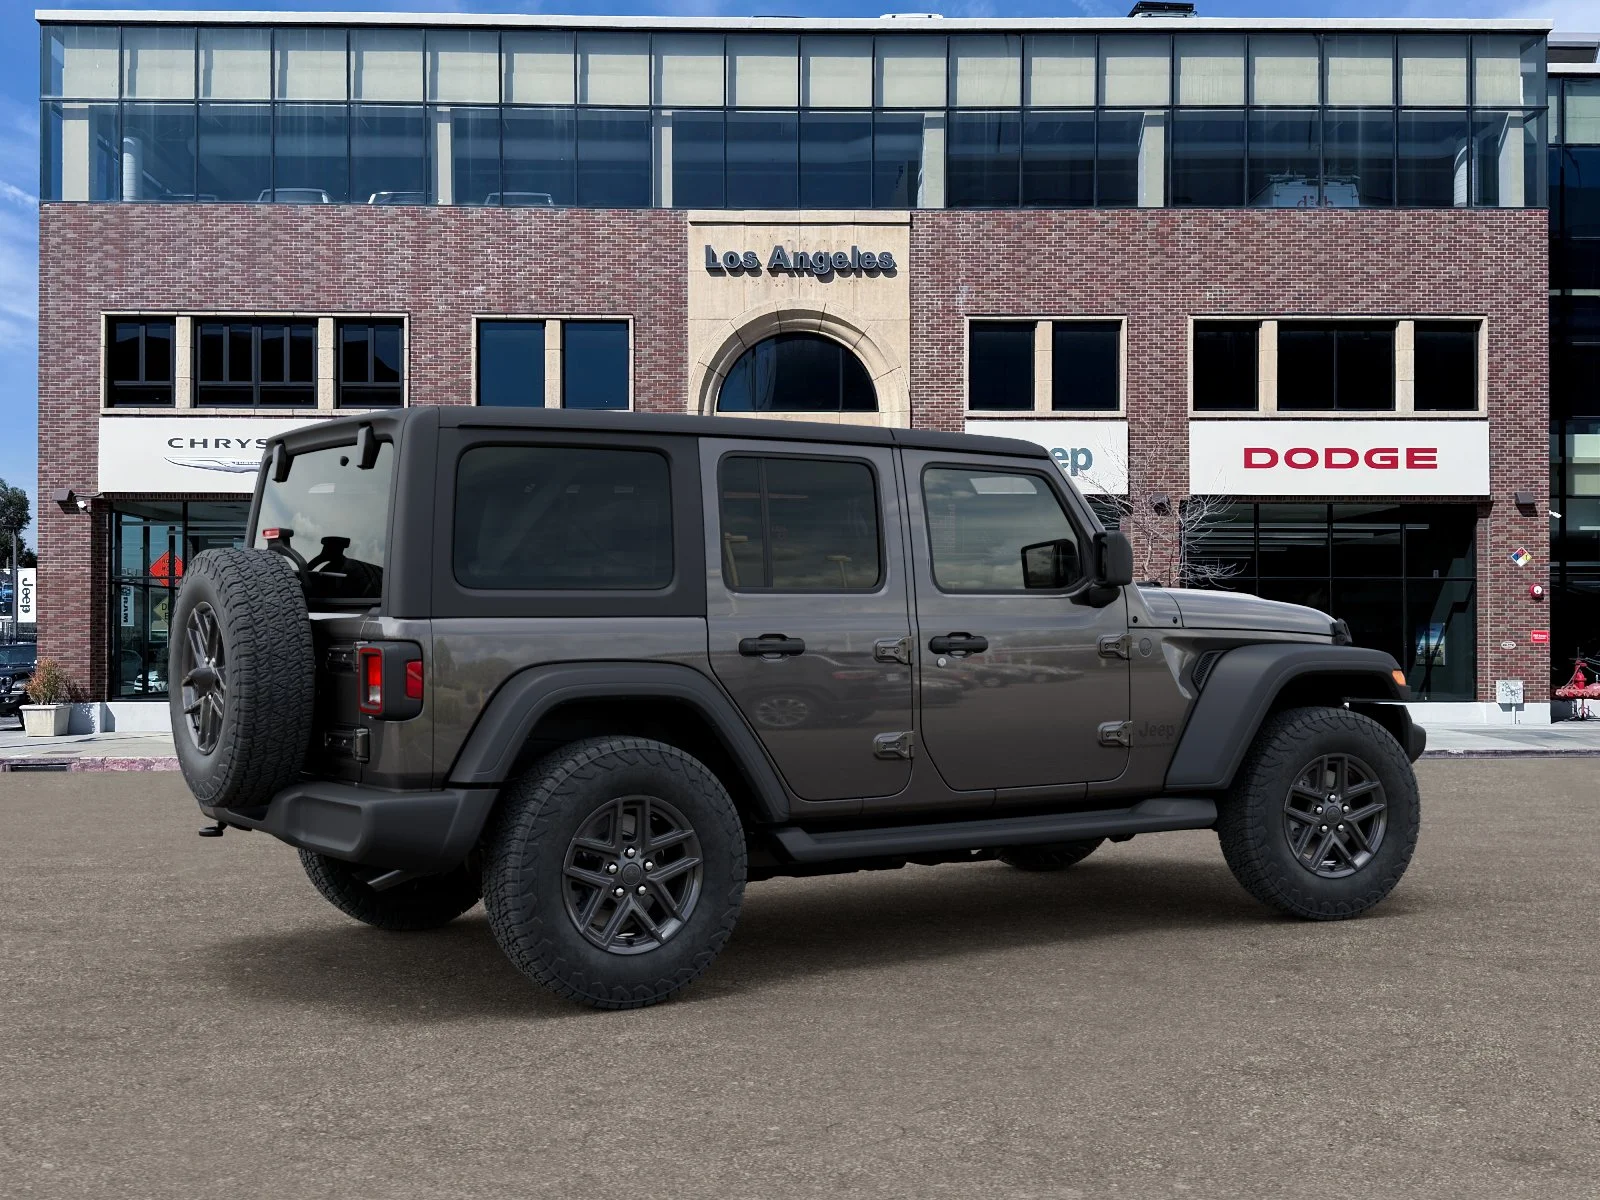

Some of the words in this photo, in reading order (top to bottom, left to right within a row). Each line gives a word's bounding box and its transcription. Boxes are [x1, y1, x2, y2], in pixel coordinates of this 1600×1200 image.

[1297, 195, 1334, 207] dih
[704, 244, 758, 269] Los
[767, 245, 894, 275] Angeles
[167, 438, 268, 449] CHRYS
[1050, 447, 1093, 477] ep
[1244, 447, 1438, 469] DODGE
[20, 577, 33, 613] Jeep
[1138, 720, 1175, 740] Jeep
